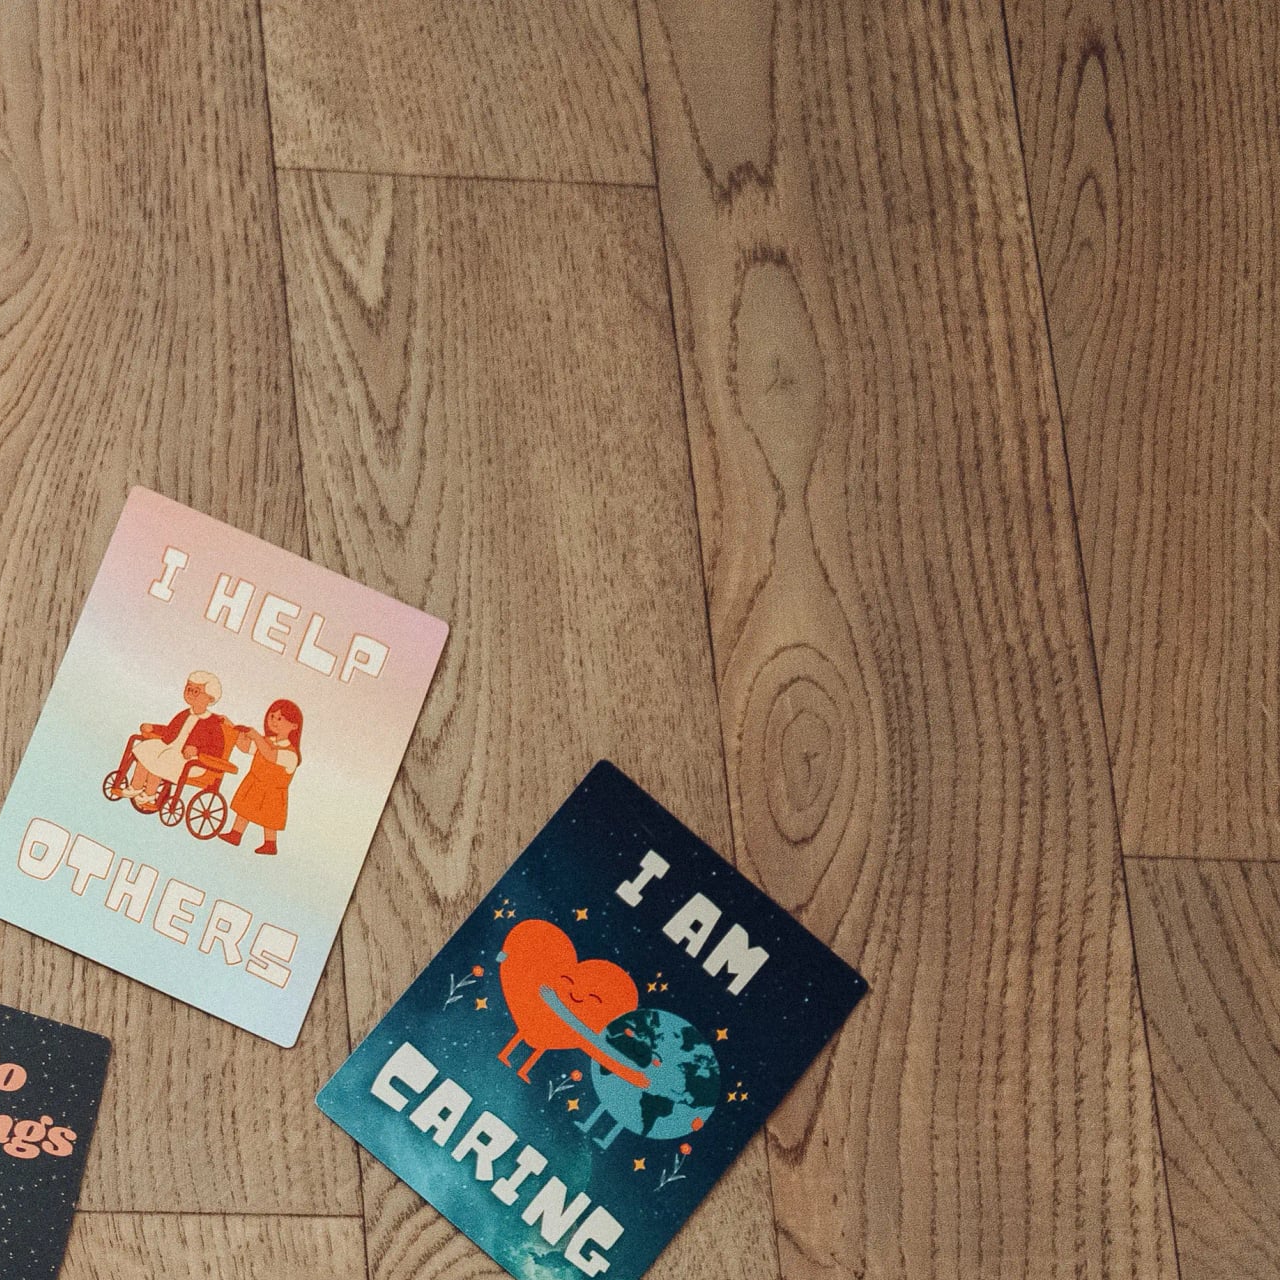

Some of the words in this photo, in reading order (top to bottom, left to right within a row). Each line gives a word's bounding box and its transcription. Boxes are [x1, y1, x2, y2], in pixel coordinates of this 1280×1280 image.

[149, 545, 189, 604] I
[204, 572, 390, 684] HELP
[16, 817, 298, 990] OTHERS
[615, 849, 671, 907] I
[662, 892, 770, 996] AM
[370, 1041, 625, 1278] CARING
